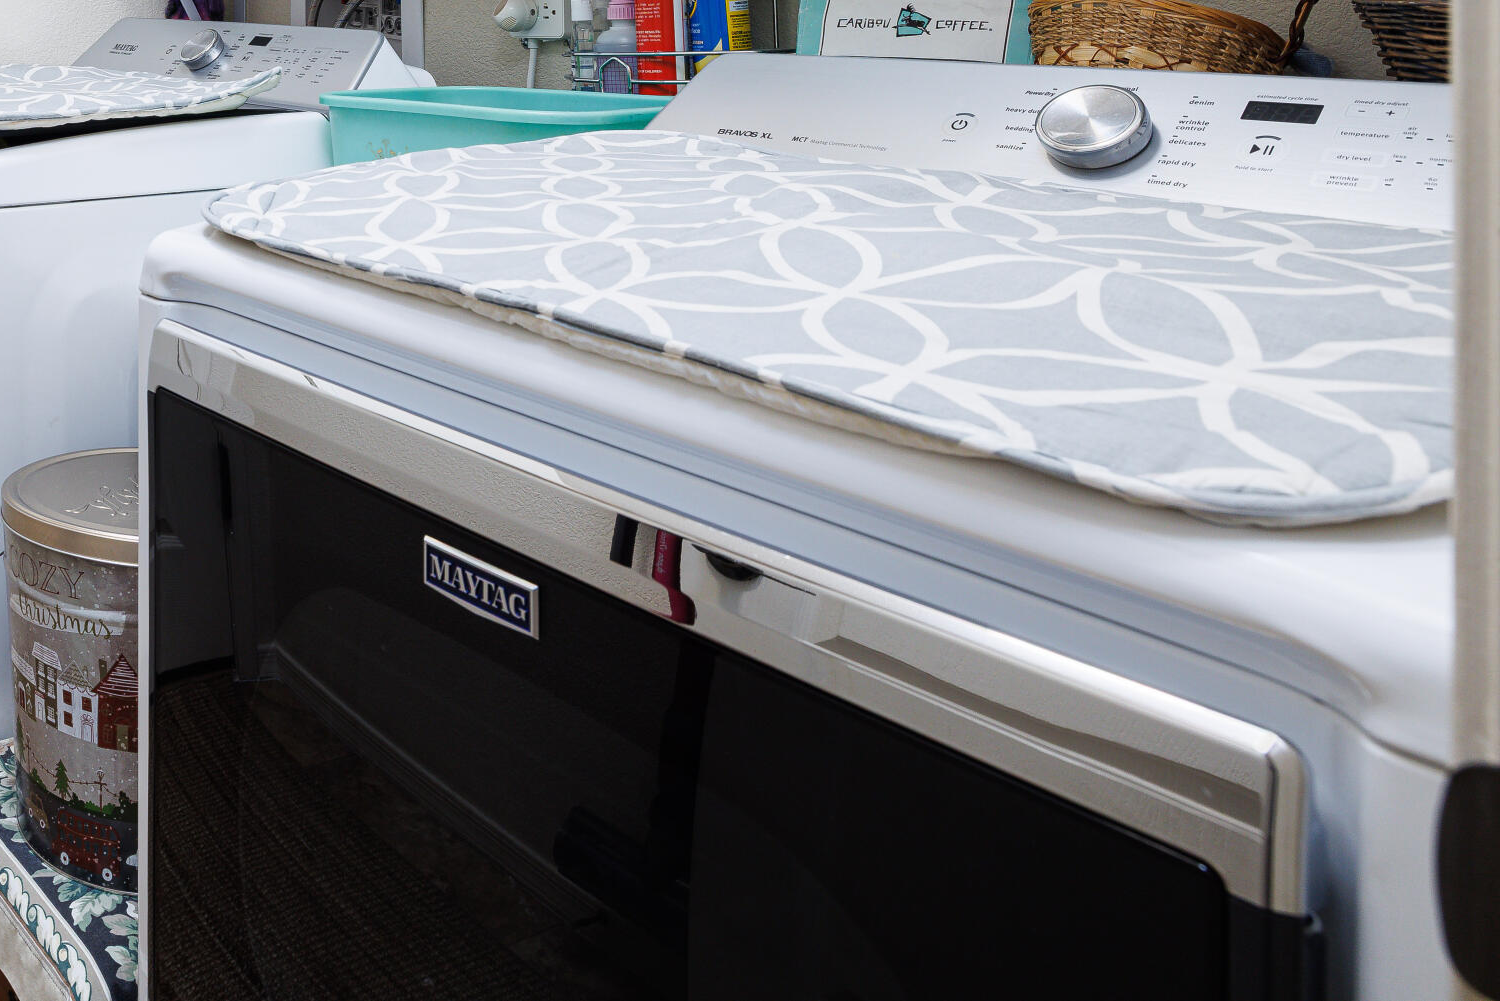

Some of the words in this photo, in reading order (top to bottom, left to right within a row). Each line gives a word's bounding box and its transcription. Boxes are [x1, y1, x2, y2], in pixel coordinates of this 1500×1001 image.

[836, 17, 893, 30] CARIBOU
[716, 128, 758, 139] BRAVOS
[759, 132, 773, 140] XL
[1005, 125, 1035, 134] bedding
[1340, 130, 1390, 139] temperature
[791, 135, 809, 143] MCT
[809, 138, 828, 146] Maytag
[858, 143, 887, 151] Technology
[995, 143, 1024, 151] sanitize
[1168, 138, 1207, 147] delicates
[1156, 158, 1179, 167] rapid
[1180, 160, 1197, 168] dry
[1147, 177, 1171, 187] timed
[1172, 180, 1188, 188] dry
[11, 545, 84, 600] COZY
[429, 552, 527, 622] MAYTAG
